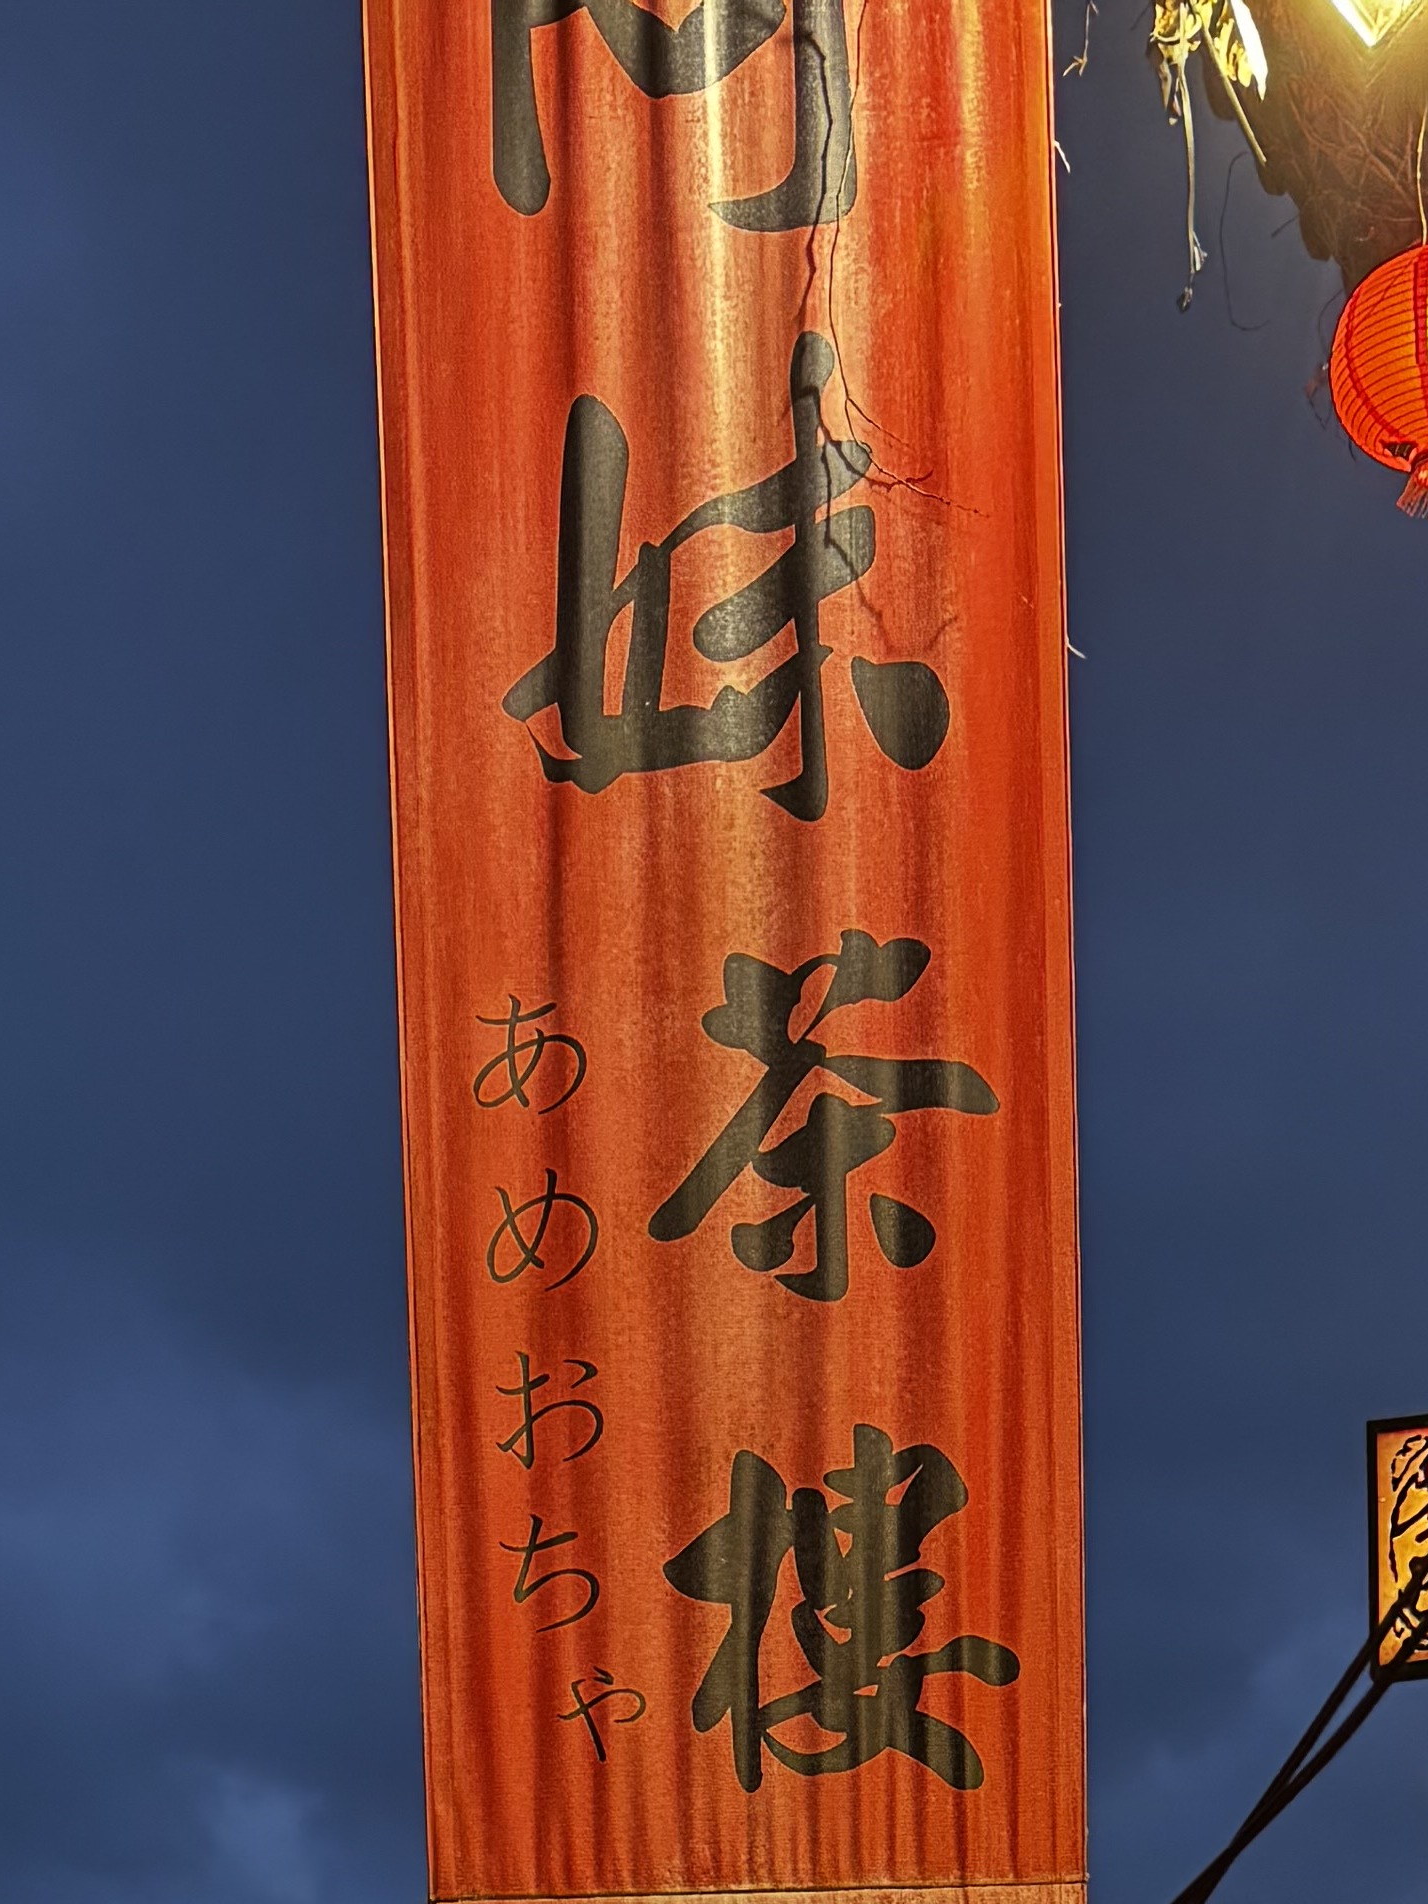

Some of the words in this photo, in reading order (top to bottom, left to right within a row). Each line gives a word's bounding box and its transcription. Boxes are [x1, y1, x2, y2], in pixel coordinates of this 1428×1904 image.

[472, 993, 647, 1763] あめおちゃ
